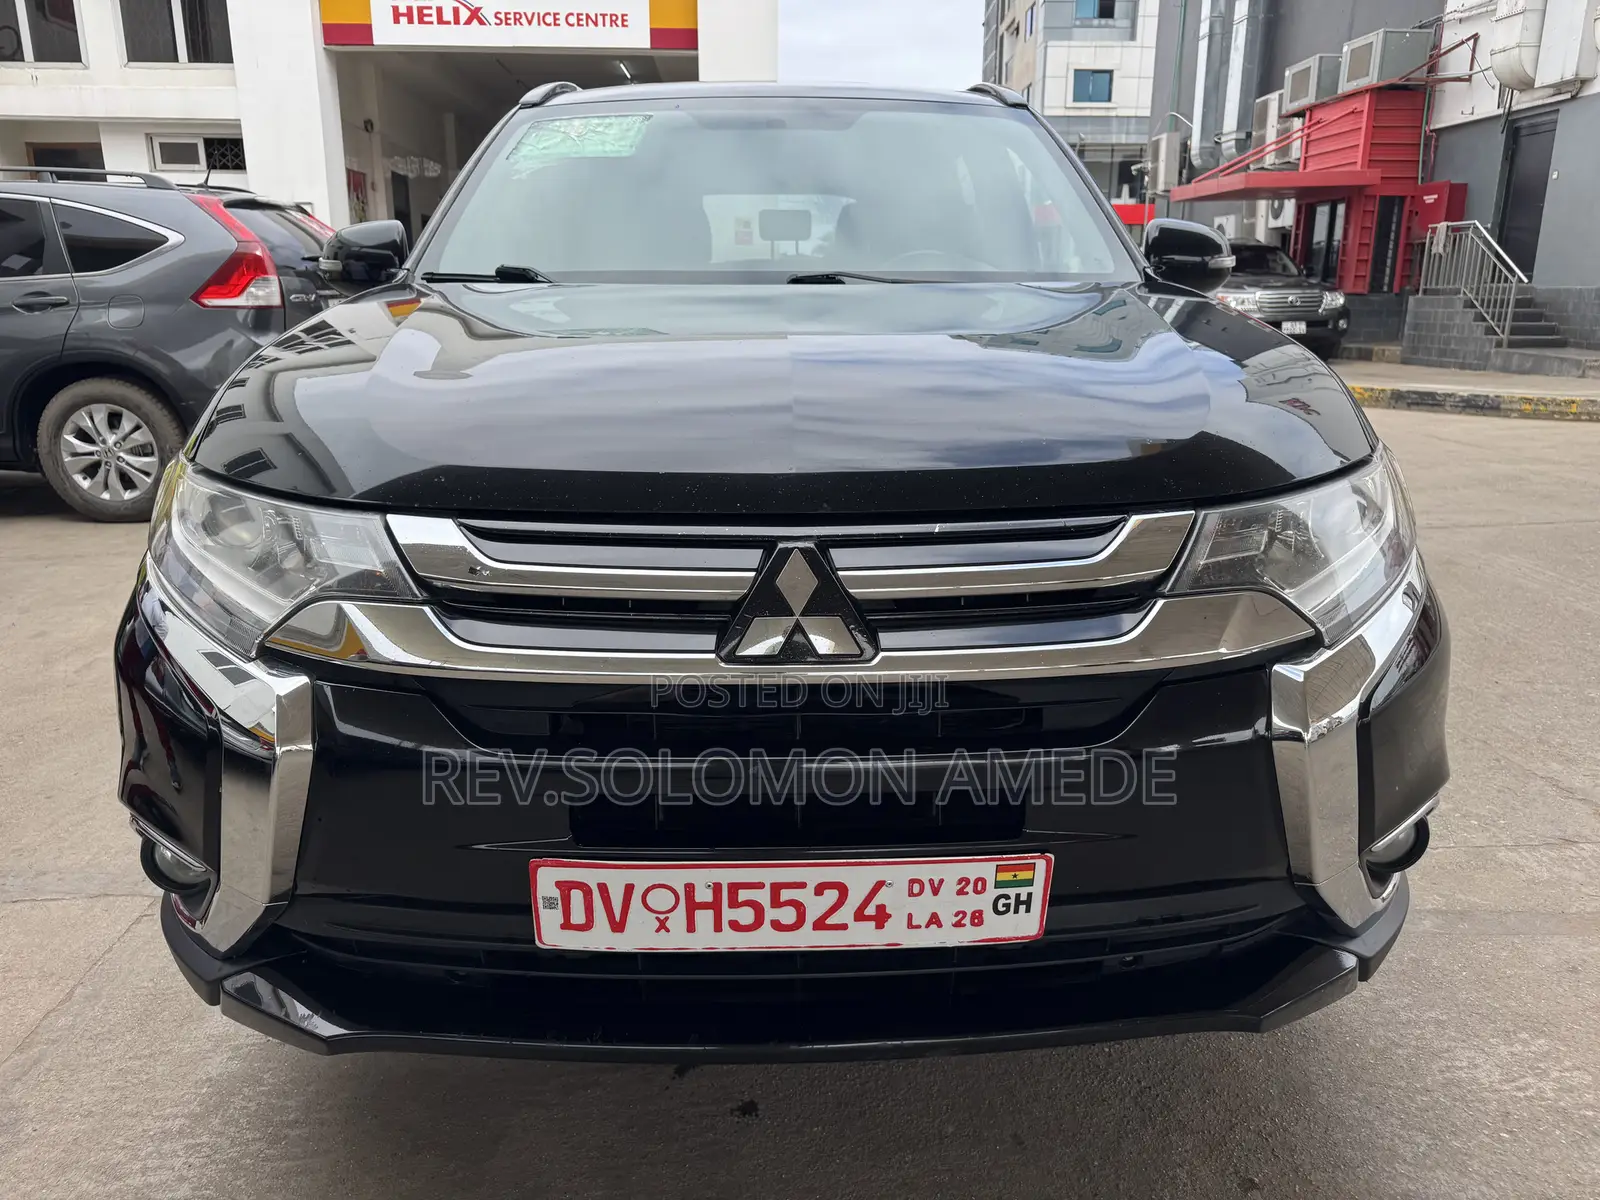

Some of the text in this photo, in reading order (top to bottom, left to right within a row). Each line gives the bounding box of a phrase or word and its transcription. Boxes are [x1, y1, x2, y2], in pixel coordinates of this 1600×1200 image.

[391, 5, 629, 28] HELIX SERVICE CENTRE
[908, 876, 987, 897] DV 20
[992, 892, 1033, 916] GH
[907, 911, 943, 929] LA
